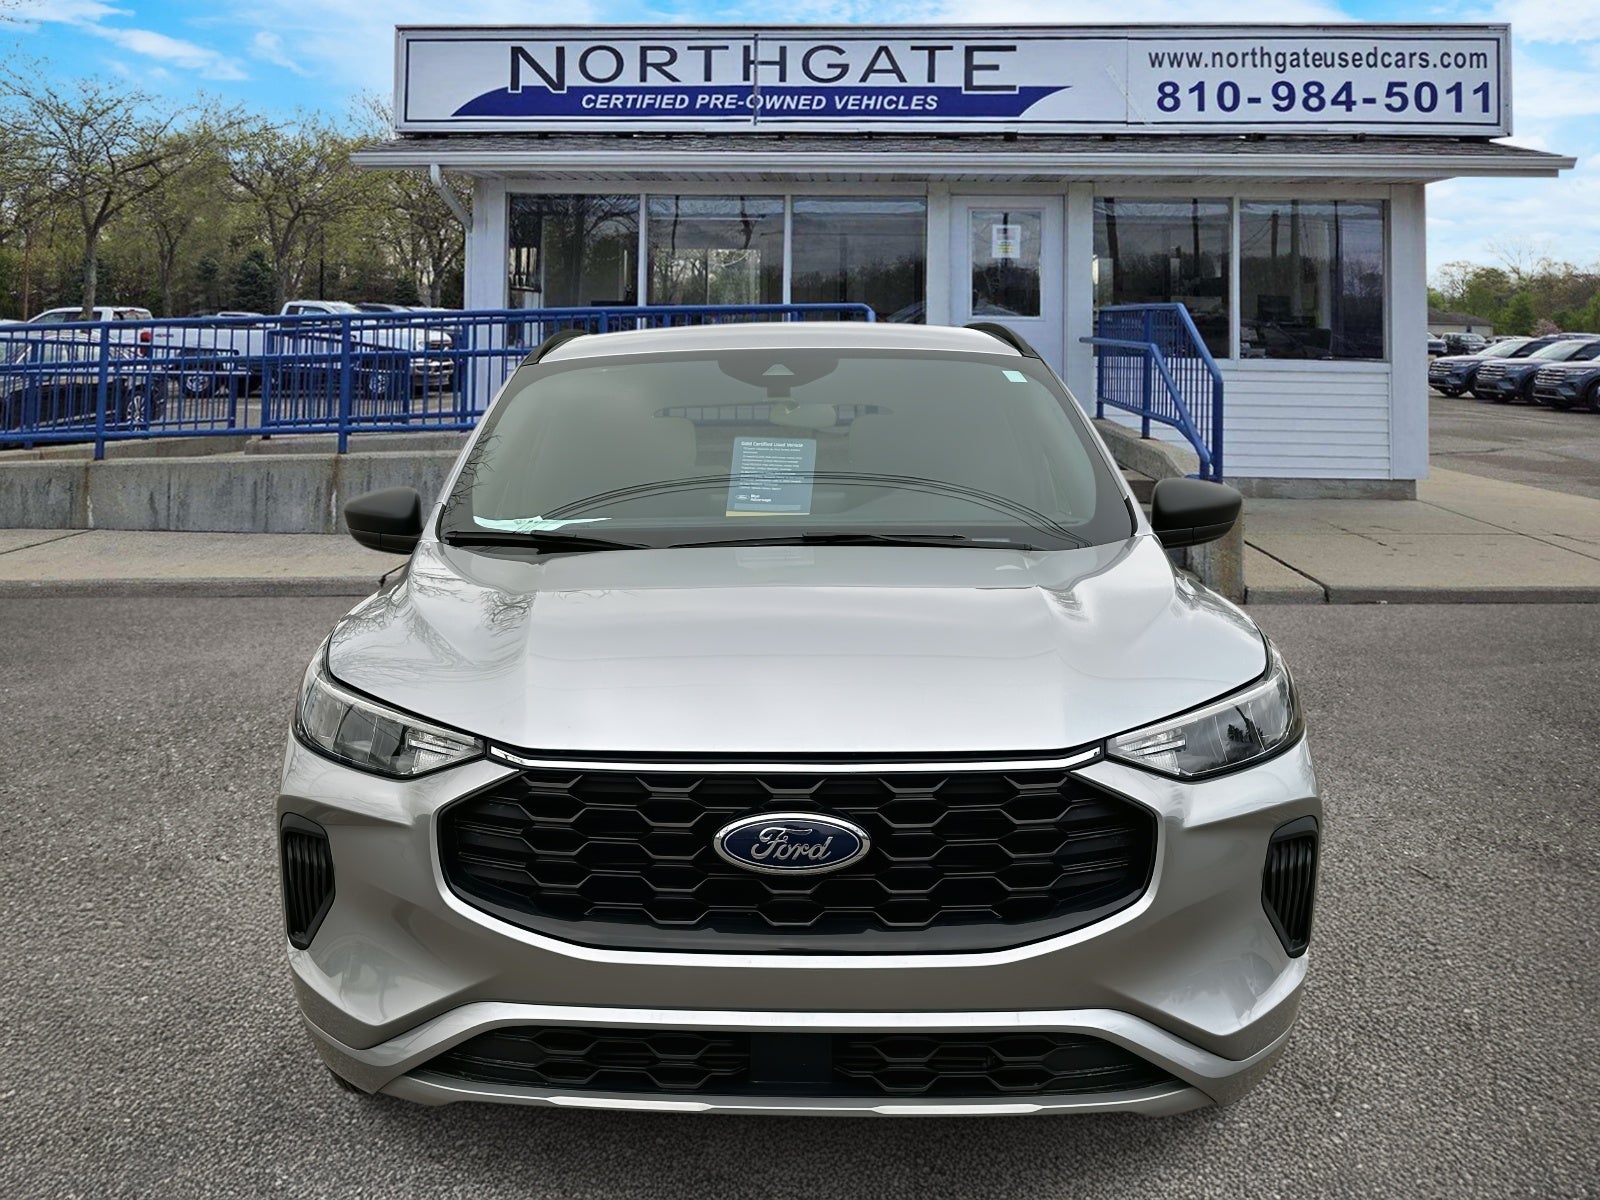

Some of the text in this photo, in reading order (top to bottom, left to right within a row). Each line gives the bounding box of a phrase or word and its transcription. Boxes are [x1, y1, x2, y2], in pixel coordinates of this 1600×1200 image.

[509, 45, 1018, 92] NORTHGATE
[1148, 47, 1489, 73] www.northgateusedcars.com
[581, 93, 938, 111] CERTIFIED PRE-OWNED VEHICLES
[1156, 80, 1491, 114] 810-984-5011
[750, 826, 833, 861] Ford
